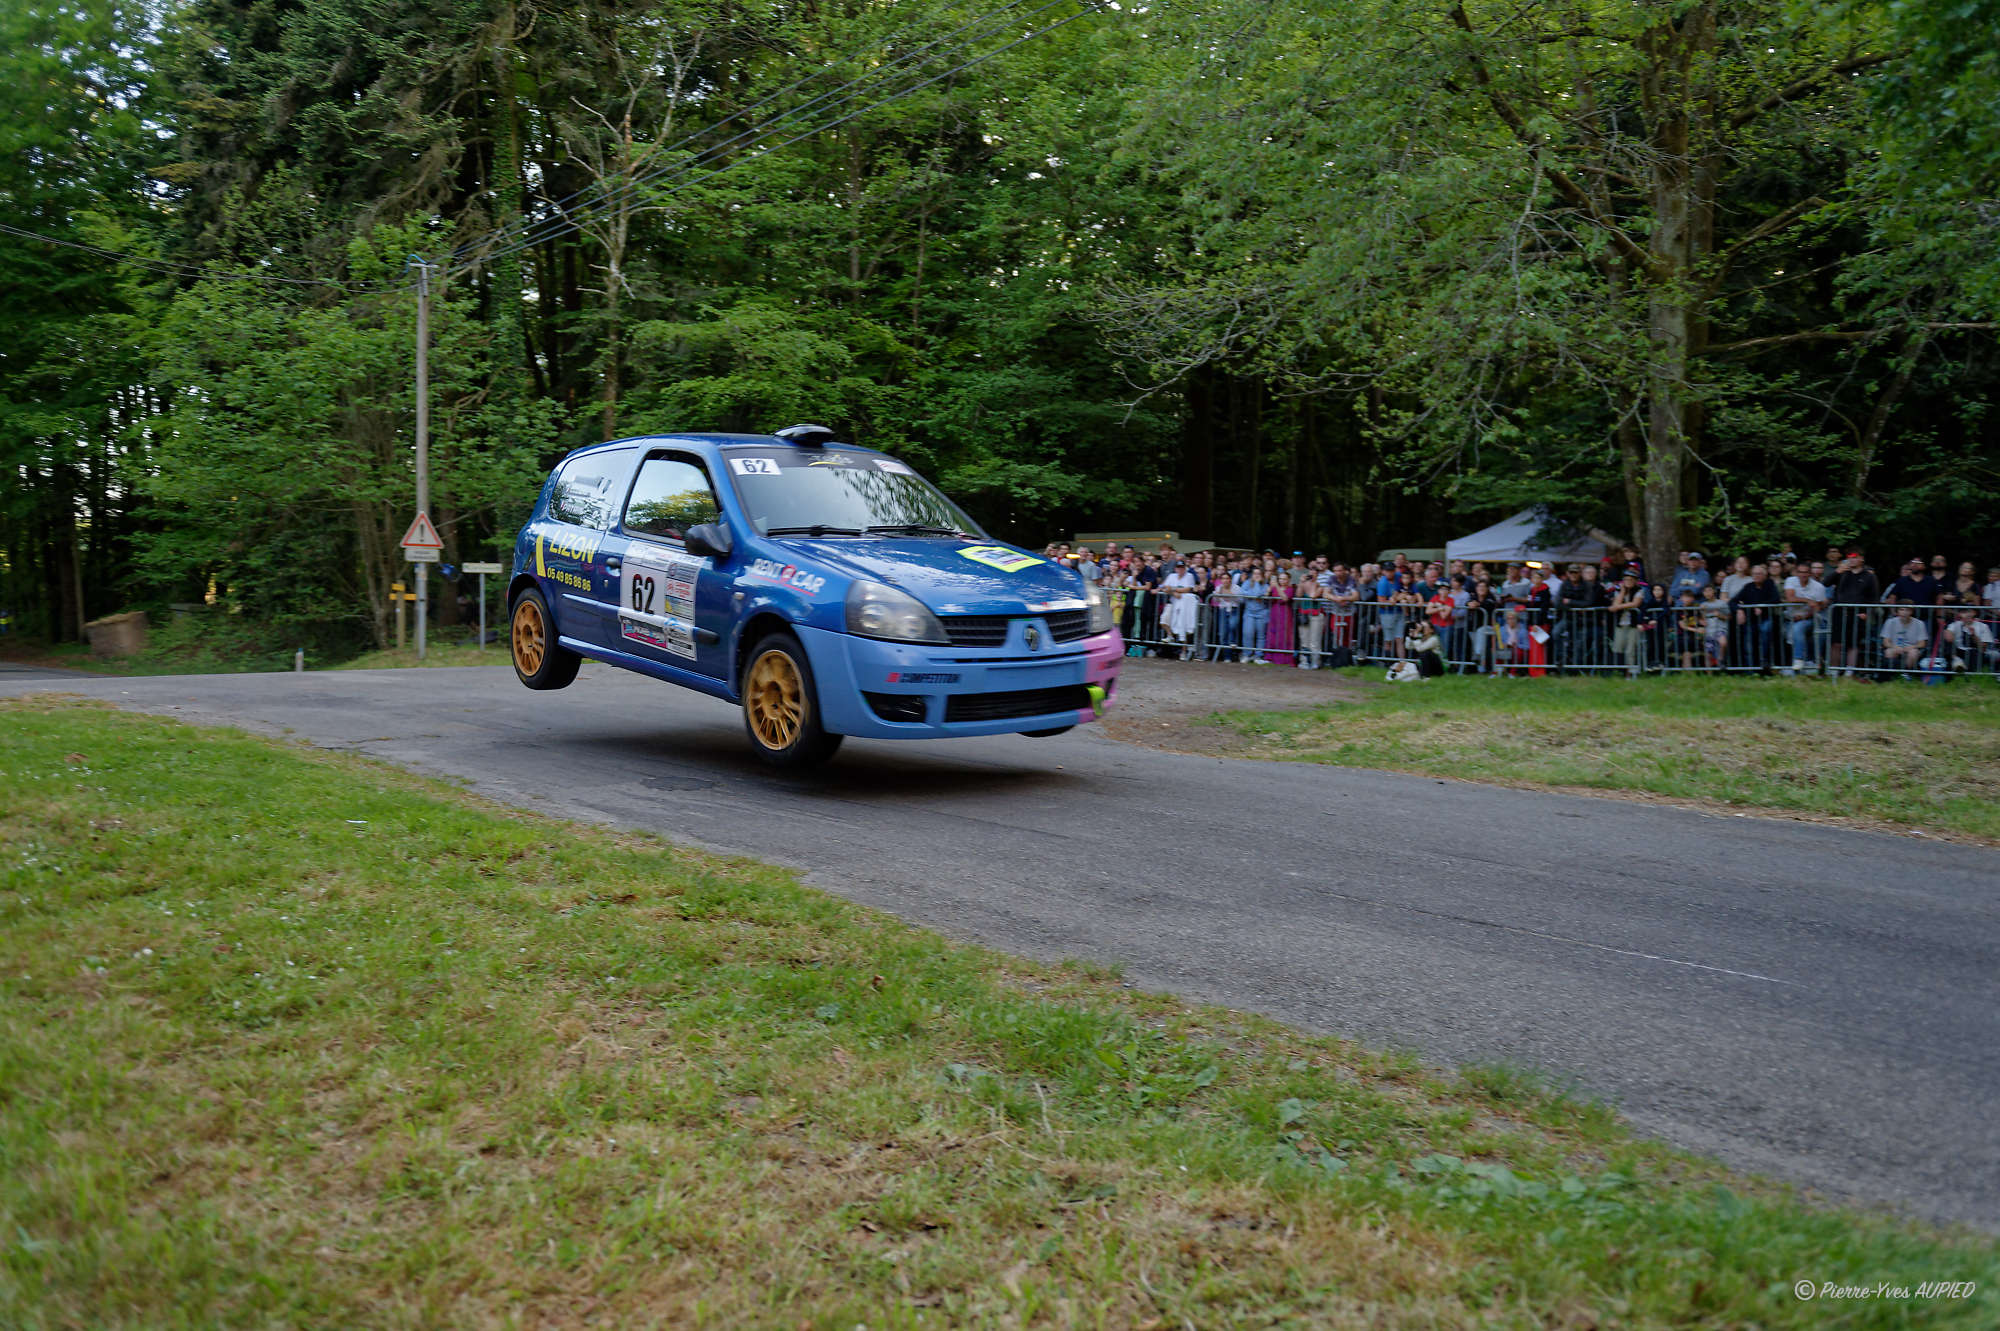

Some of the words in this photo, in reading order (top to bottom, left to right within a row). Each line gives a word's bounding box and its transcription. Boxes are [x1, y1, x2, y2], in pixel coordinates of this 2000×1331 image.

[743, 459, 769, 474] 62
[549, 530, 600, 563] LIZON
[547, 567, 556, 580] 05
[556, 570, 564, 583] 49
[752, 558, 785, 578] RENT
[791, 570, 826, 593] CAR
[631, 573, 655, 615] 62
